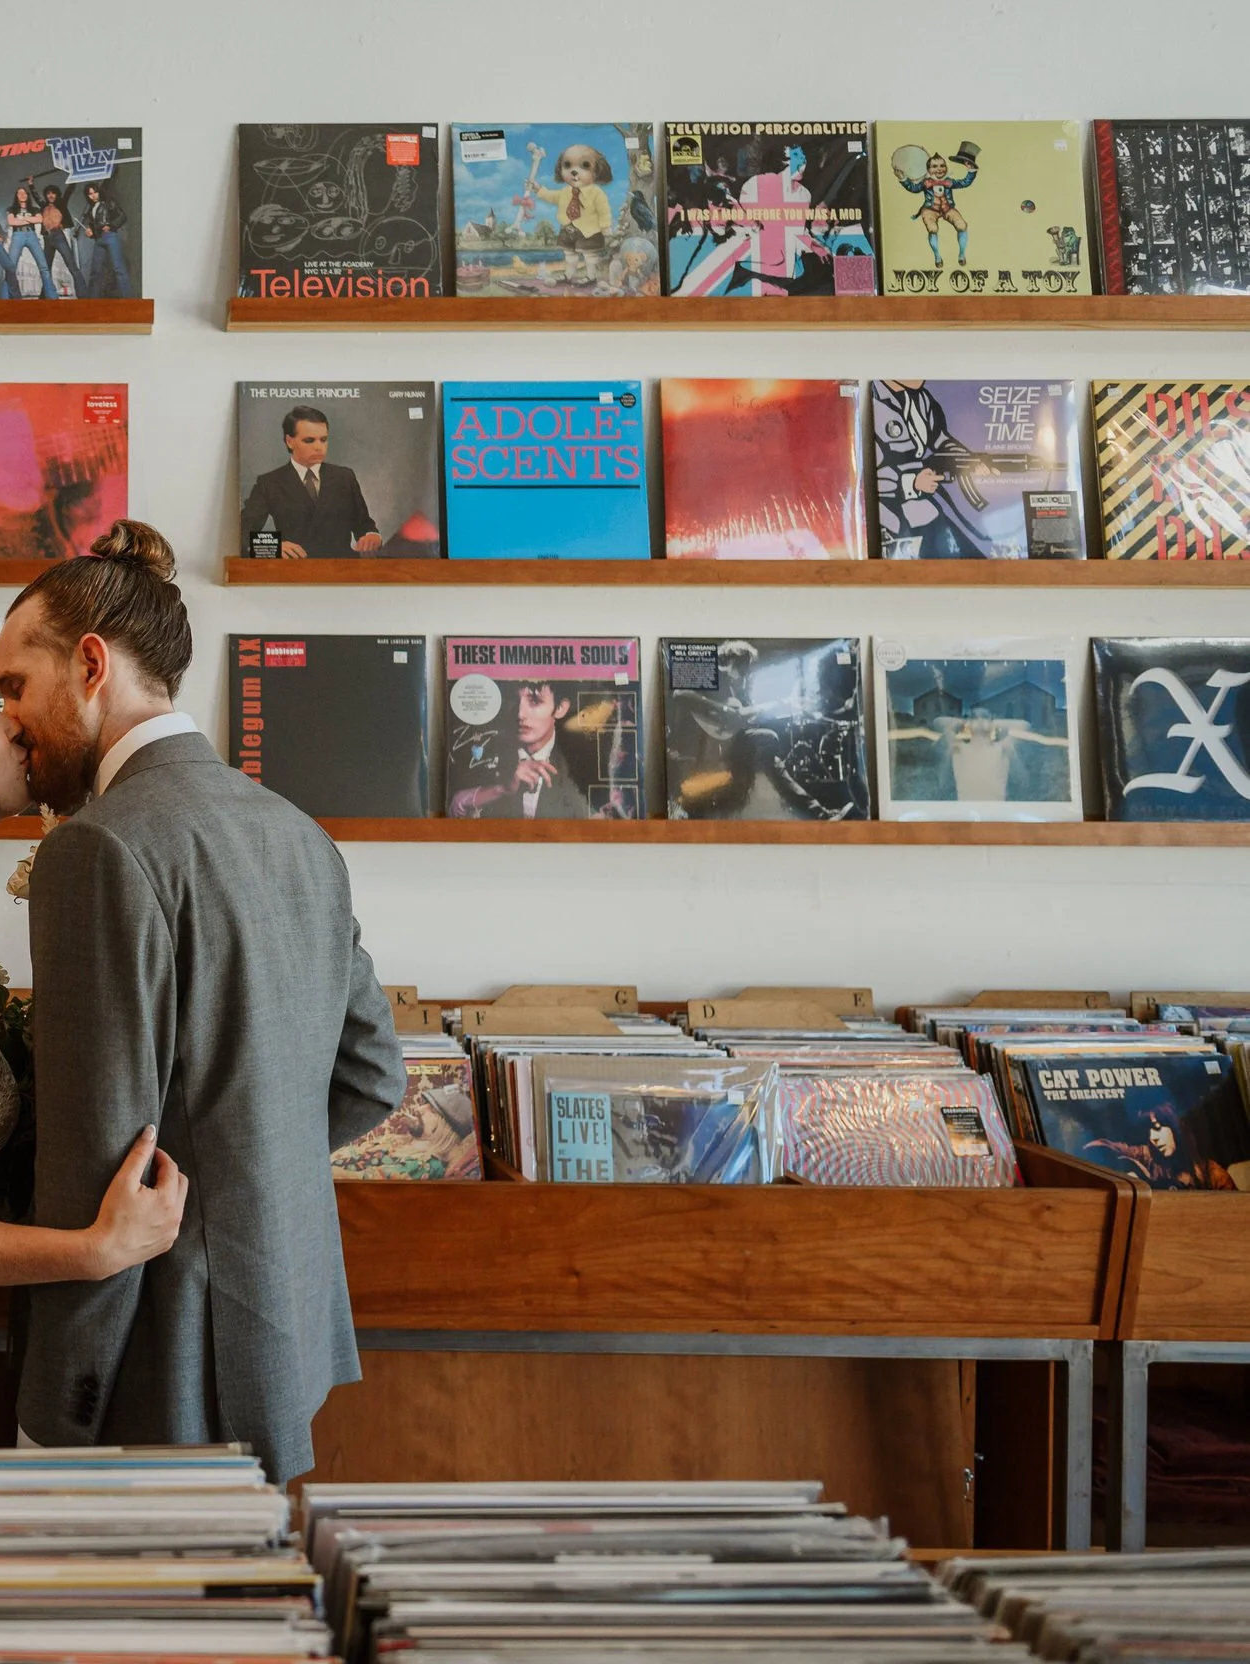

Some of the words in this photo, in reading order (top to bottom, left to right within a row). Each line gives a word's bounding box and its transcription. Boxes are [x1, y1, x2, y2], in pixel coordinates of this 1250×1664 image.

[667, 123, 751, 135] TELEVISION
[755, 122, 867, 135] PERSONALITIES
[687, 208, 710, 221] WAS
[720, 208, 745, 221] MOD
[805, 208, 828, 221] WAS
[829, 208, 837, 221] A
[839, 208, 862, 221] MOD
[250, 269, 430, 298] Television
[887, 269, 944, 292] JOY
[950, 269, 989, 292] OF
[993, 269, 1018, 292] A
[1022, 269, 1081, 292] TOY
[250, 388, 268, 398] THE
[269, 388, 315, 398] PLEASURE
[316, 388, 360, 398] PRINCIPLE
[978, 386, 1042, 404] SEIZE
[86, 400, 118, 408] loveless
[451, 405, 638, 440] ADOLE-
[989, 405, 1031, 422] THE
[984, 423, 1035, 441] TIME
[452, 445, 640, 480] SCENTS
[453, 645, 496, 665] THESE
[500, 645, 576, 665] IMMORTAL
[581, 645, 629, 665] SOULS
[396, 991, 407, 1006] K
[614, 990, 628, 1005] G
[702, 1004, 716, 1019] D
[1038, 1069, 1079, 1089] CAT
[1085, 1067, 1162, 1087] POWER
[1043, 1090, 1067, 1101] THE
[1069, 1088, 1125, 1100] GREATEST
[557, 1121, 608, 1145] LIVE!
[557, 1158, 610, 1181] THE
